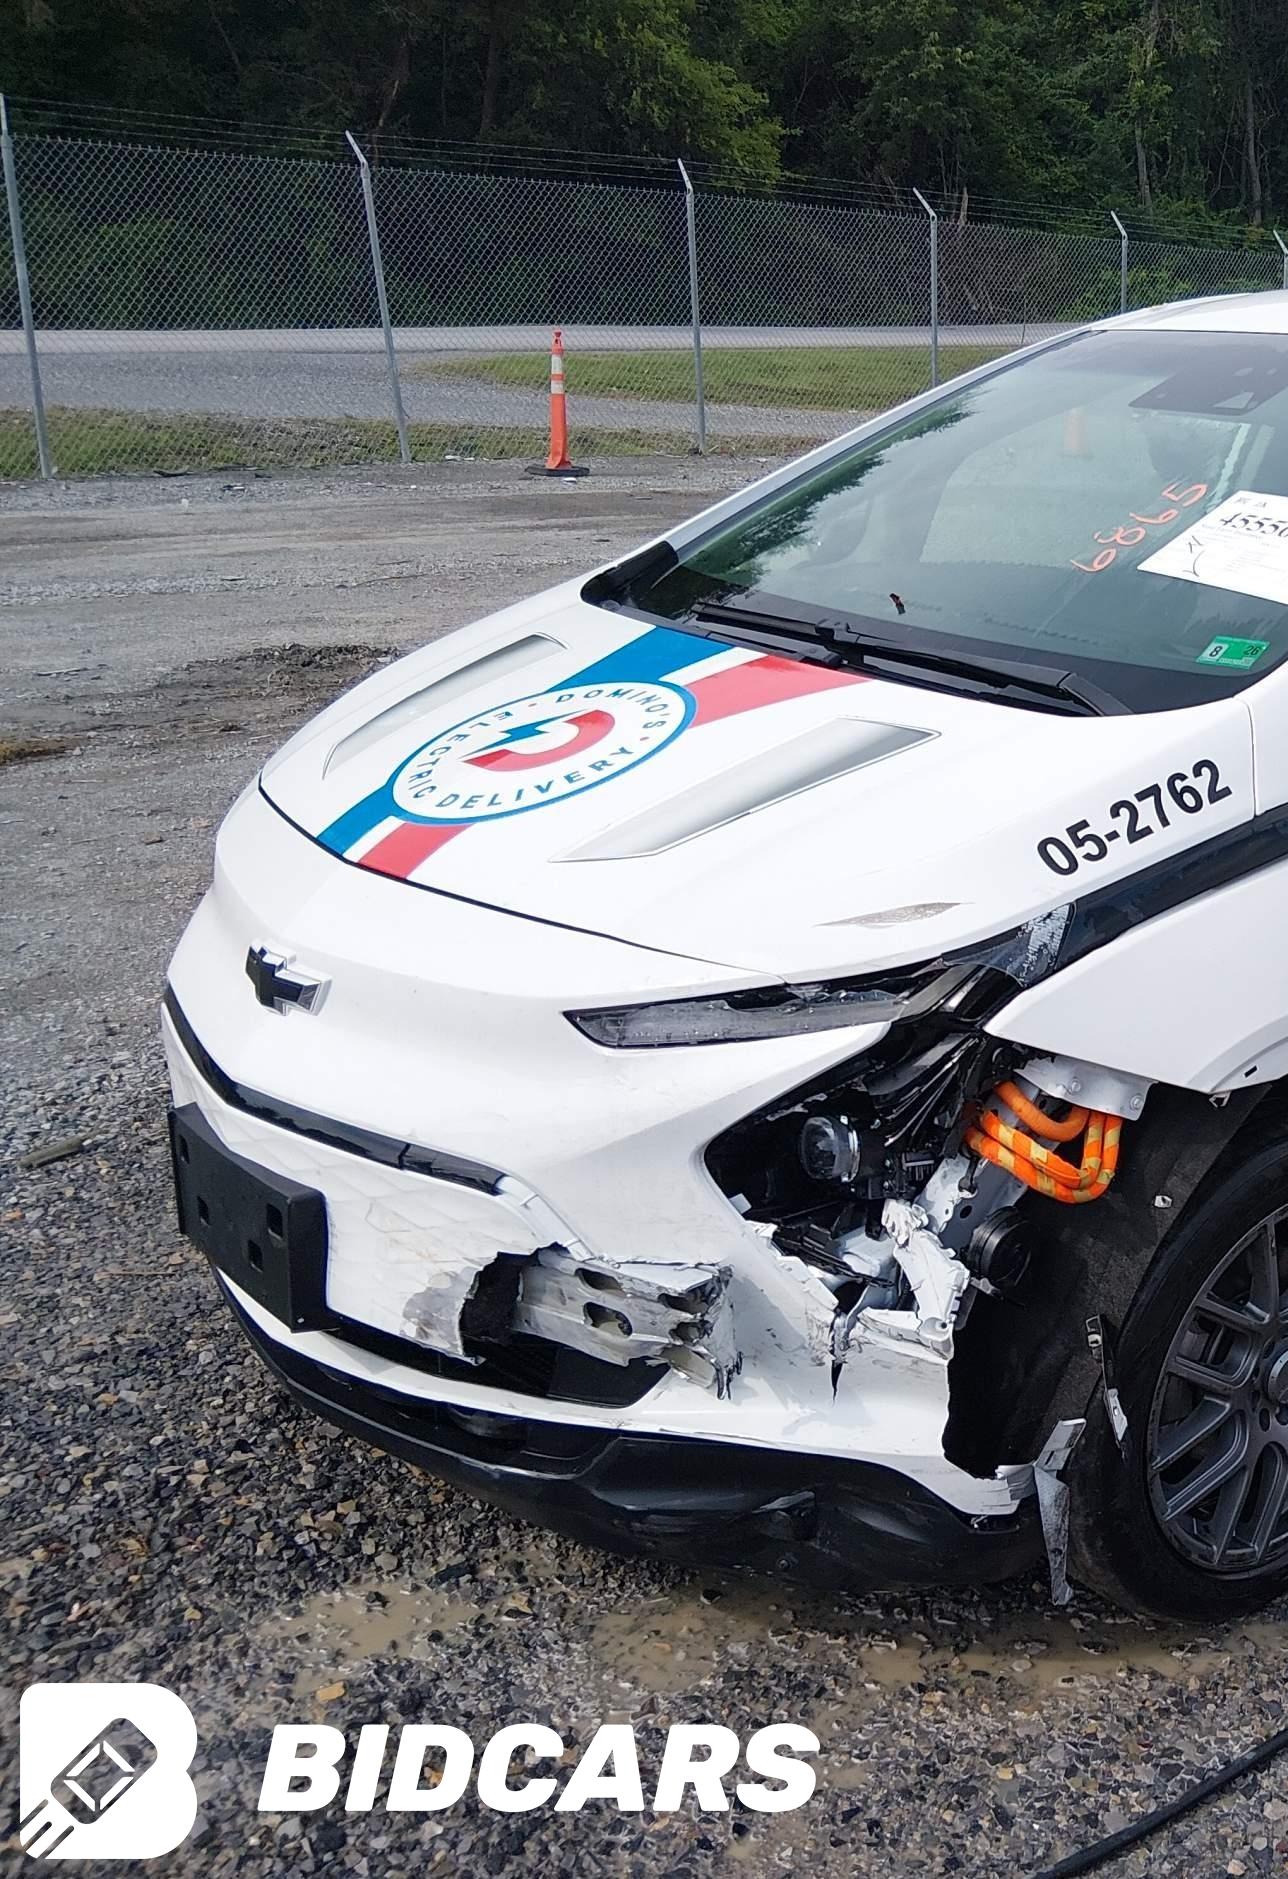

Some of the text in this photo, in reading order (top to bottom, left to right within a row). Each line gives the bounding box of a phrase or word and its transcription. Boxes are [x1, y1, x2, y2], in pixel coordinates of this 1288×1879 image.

[1069, 479, 1207, 572] 6865
[1208, 645, 1224, 658] 8
[555, 688, 672, 731] DOMINO'S
[408, 711, 634, 810] ELECTRIC DELIVERY
[1036, 759, 1233, 876] 05-2762
